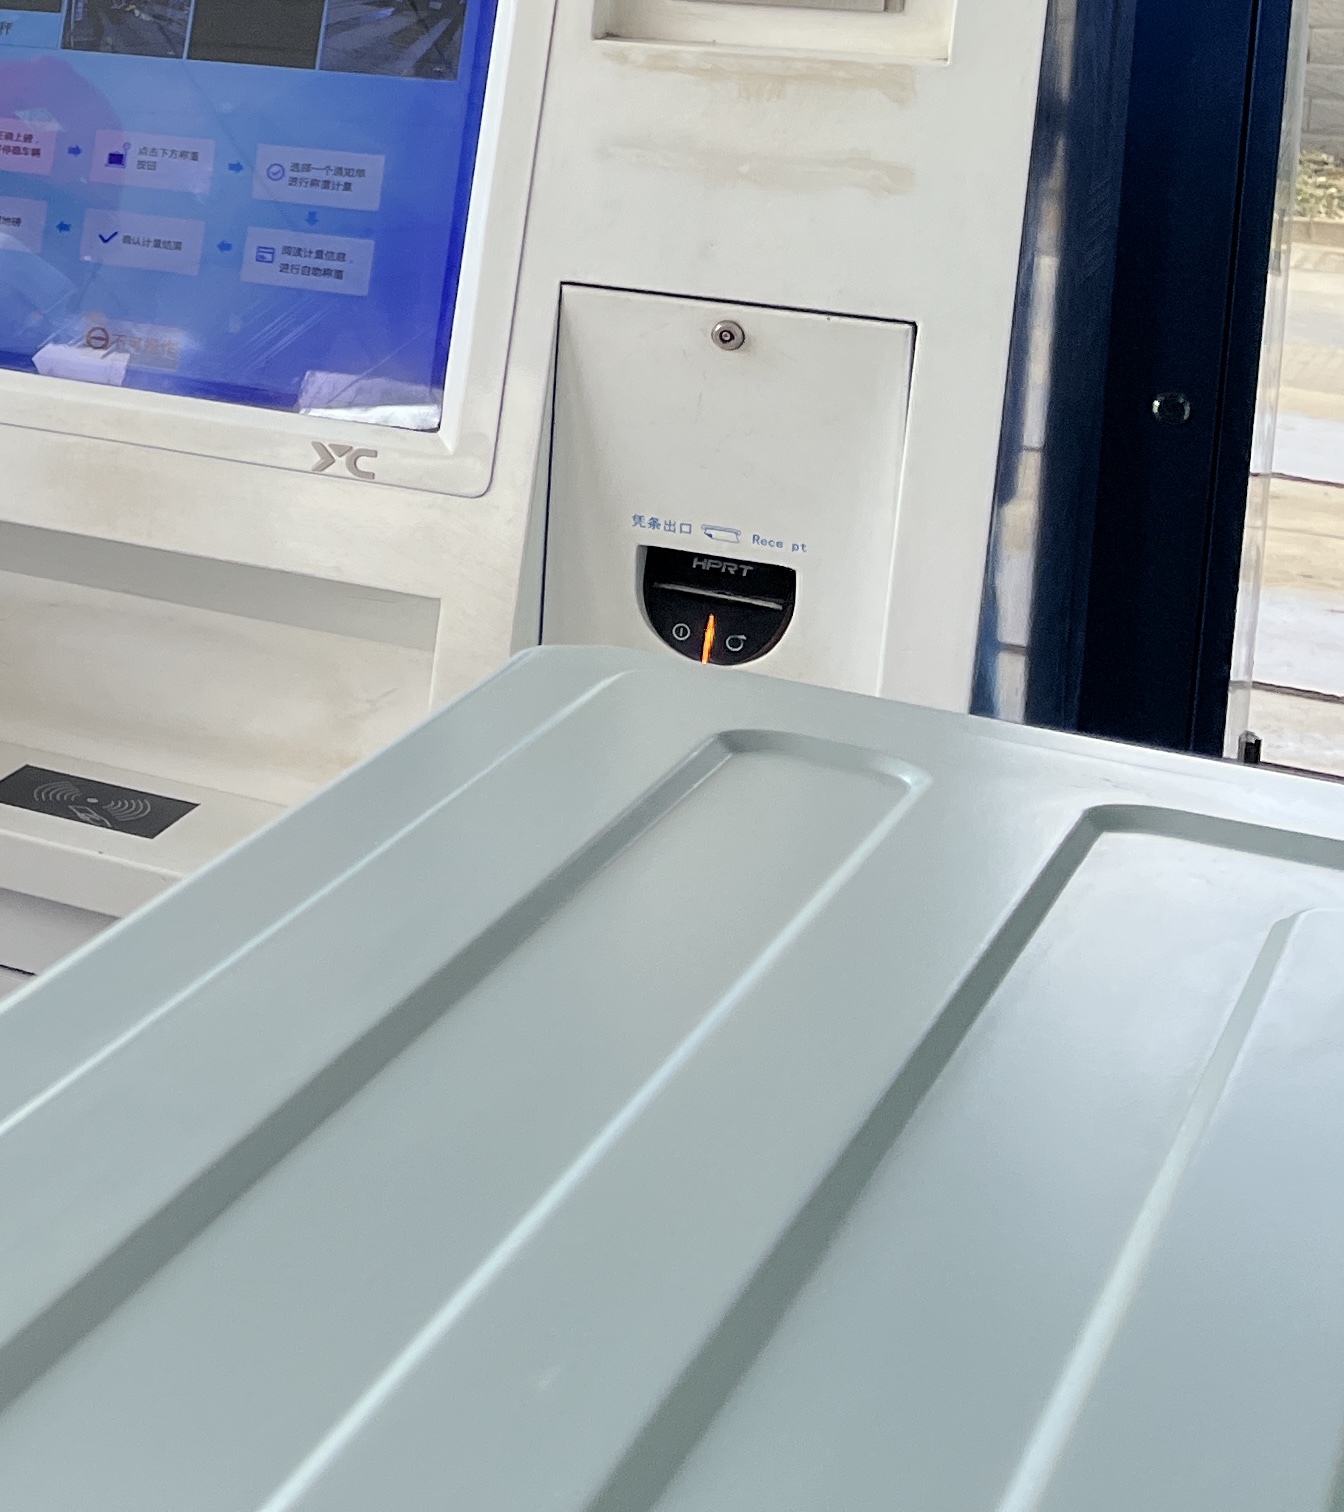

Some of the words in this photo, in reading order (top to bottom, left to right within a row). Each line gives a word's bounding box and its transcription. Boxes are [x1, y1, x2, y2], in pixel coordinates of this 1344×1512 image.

[632, 514, 693, 535] 凭条出口
[752, 534, 808, 553] Recept
[692, 556, 754, 577] HPRT
